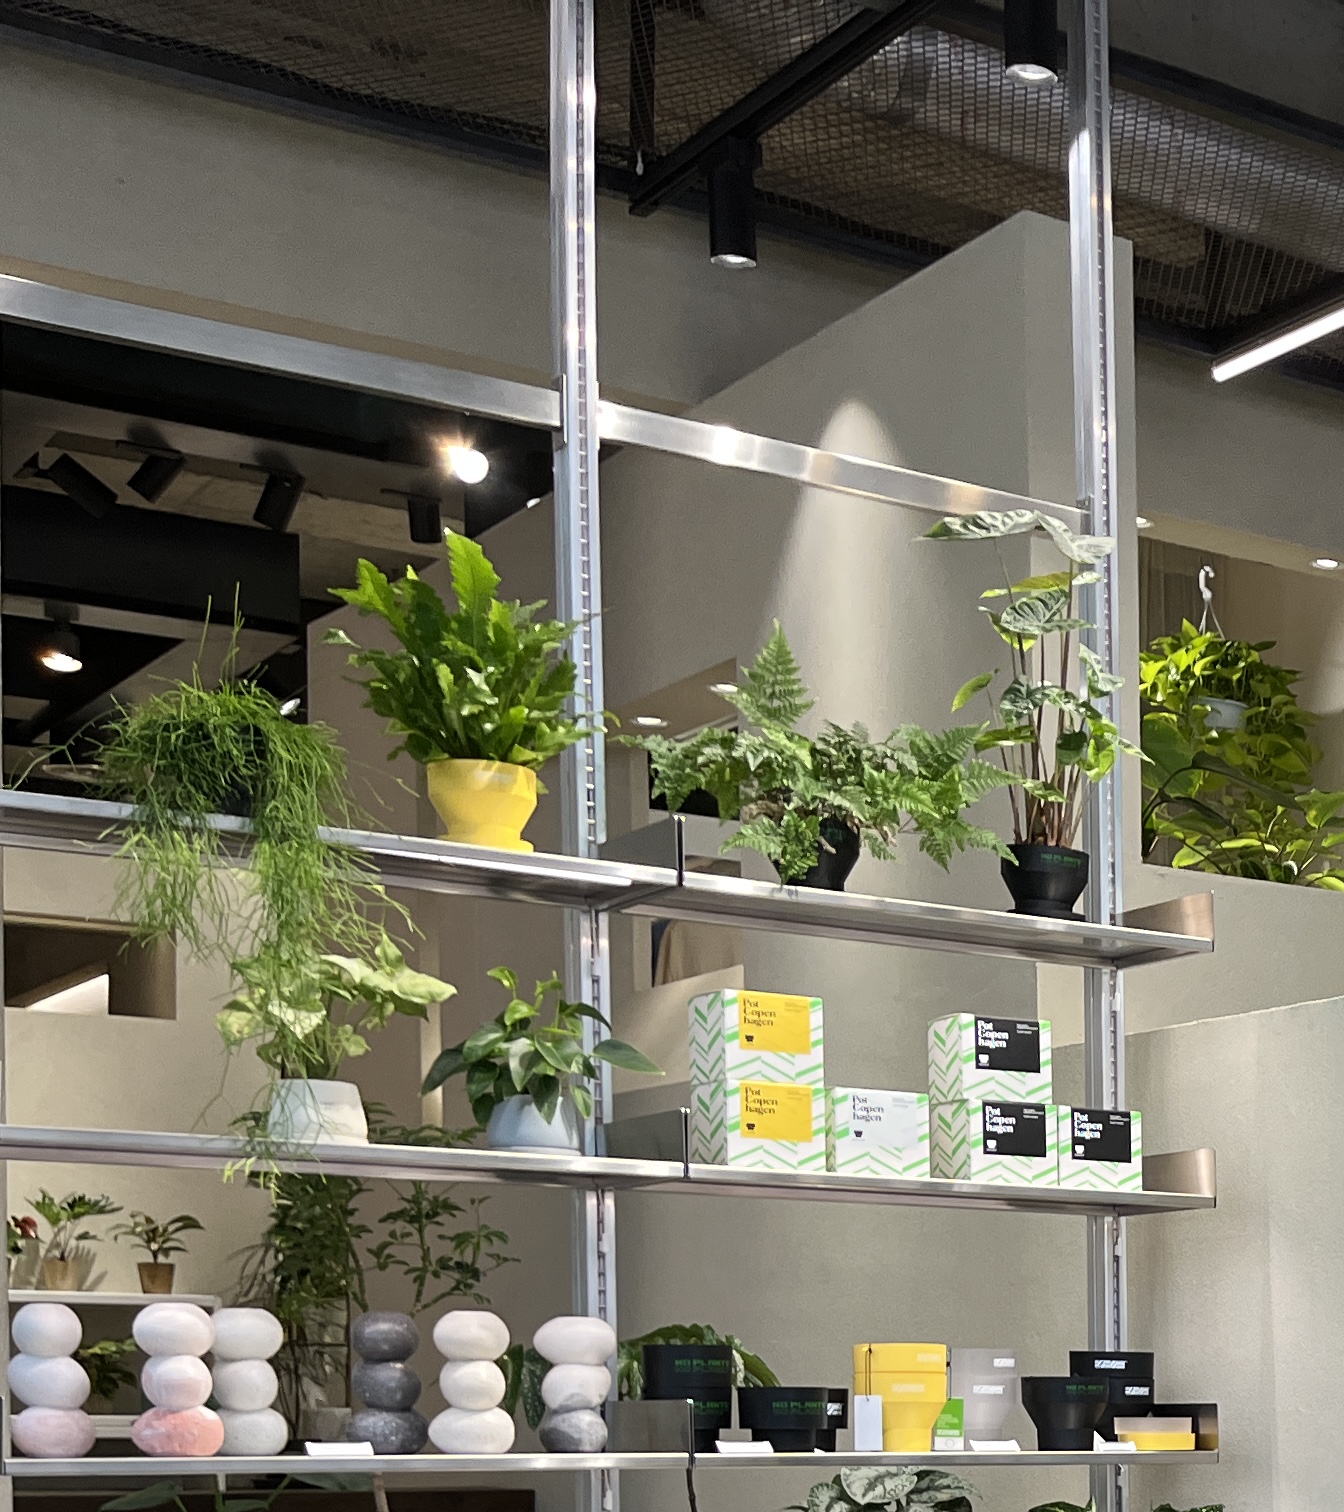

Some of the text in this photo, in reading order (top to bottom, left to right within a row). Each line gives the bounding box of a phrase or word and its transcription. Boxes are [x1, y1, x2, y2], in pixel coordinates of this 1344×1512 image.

[742, 997, 759, 1008] Pot
[977, 1020, 994, 1030] Pot
[745, 1087, 761, 1096] Pot
[852, 1095, 868, 1104] Pot
